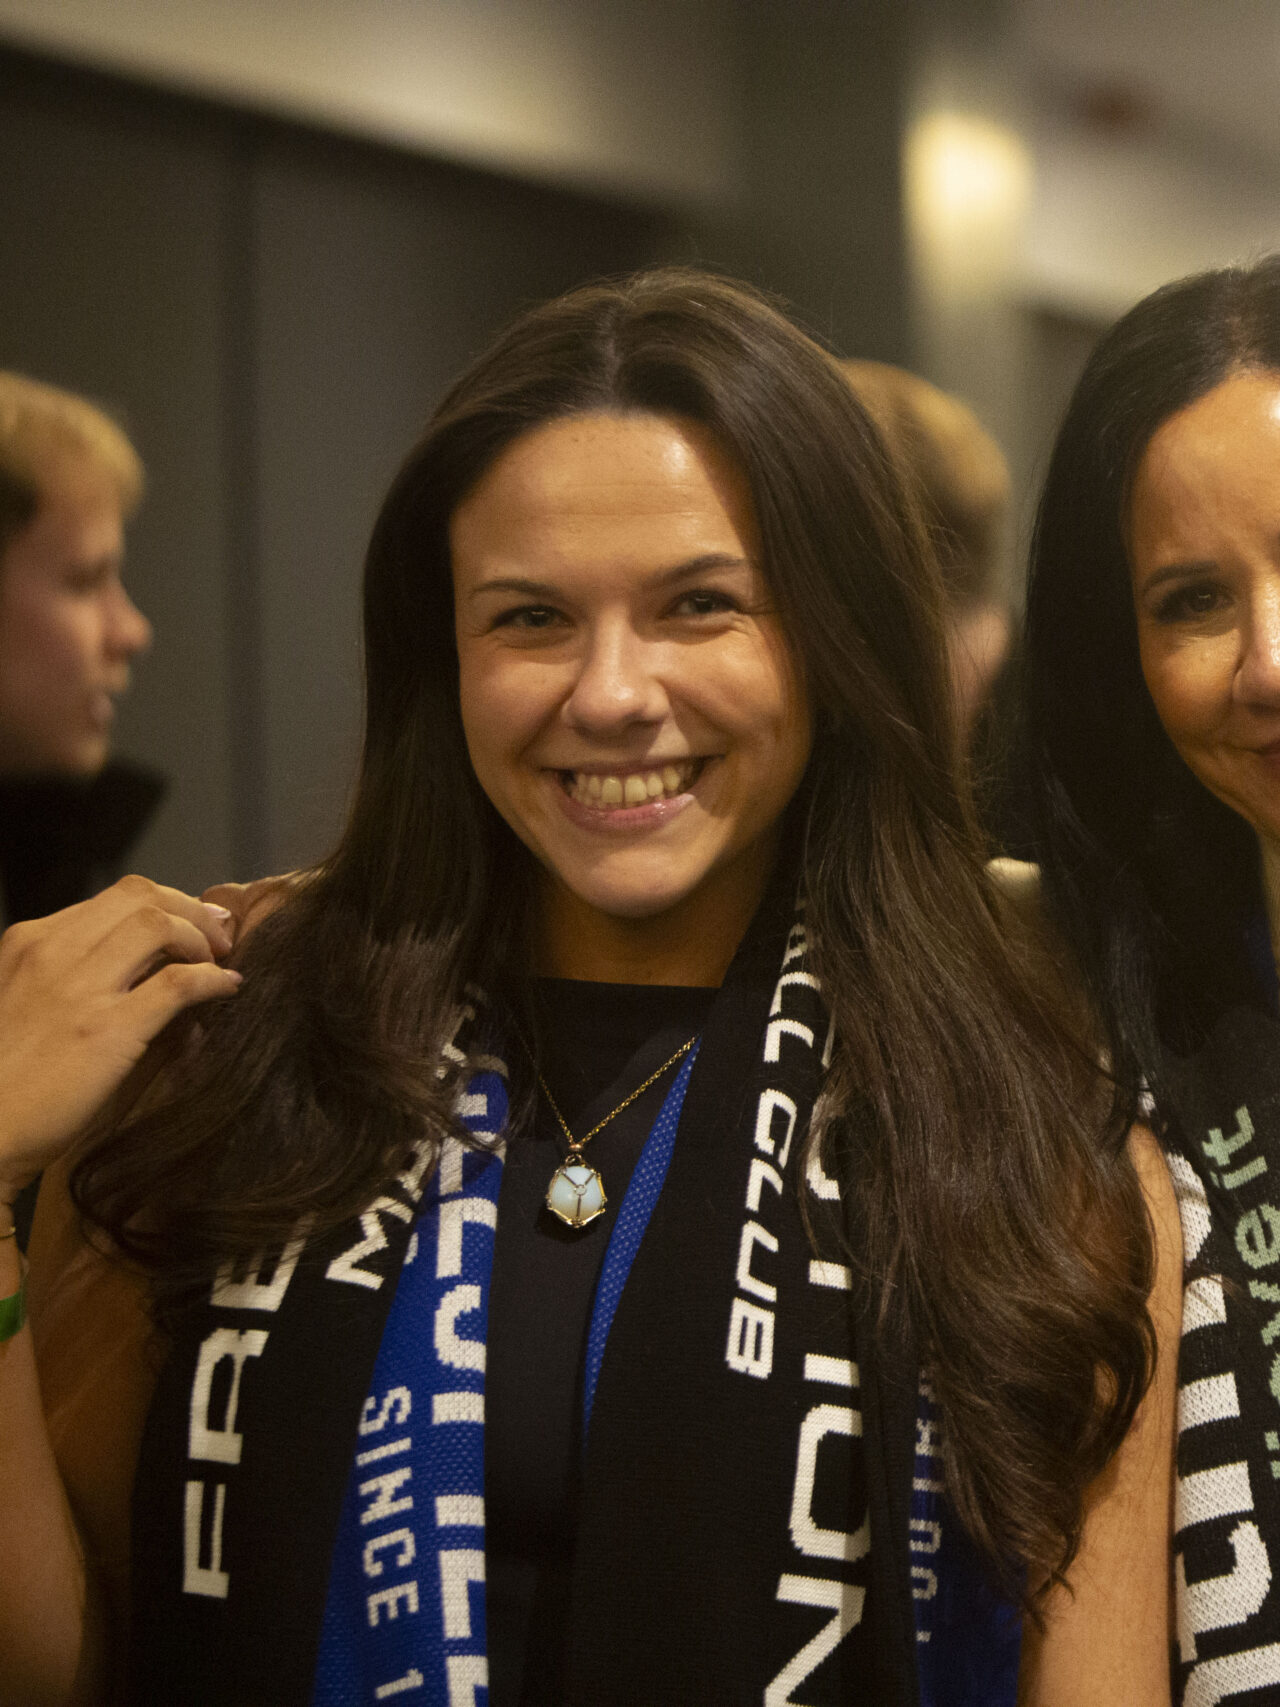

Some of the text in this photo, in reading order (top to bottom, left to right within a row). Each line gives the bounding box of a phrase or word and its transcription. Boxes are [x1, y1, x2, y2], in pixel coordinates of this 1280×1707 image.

[726, 1088, 797, 1380] CLUB
[1202, 1104, 1267, 1190] it
[356, 1386, 418, 1627] SINCE
